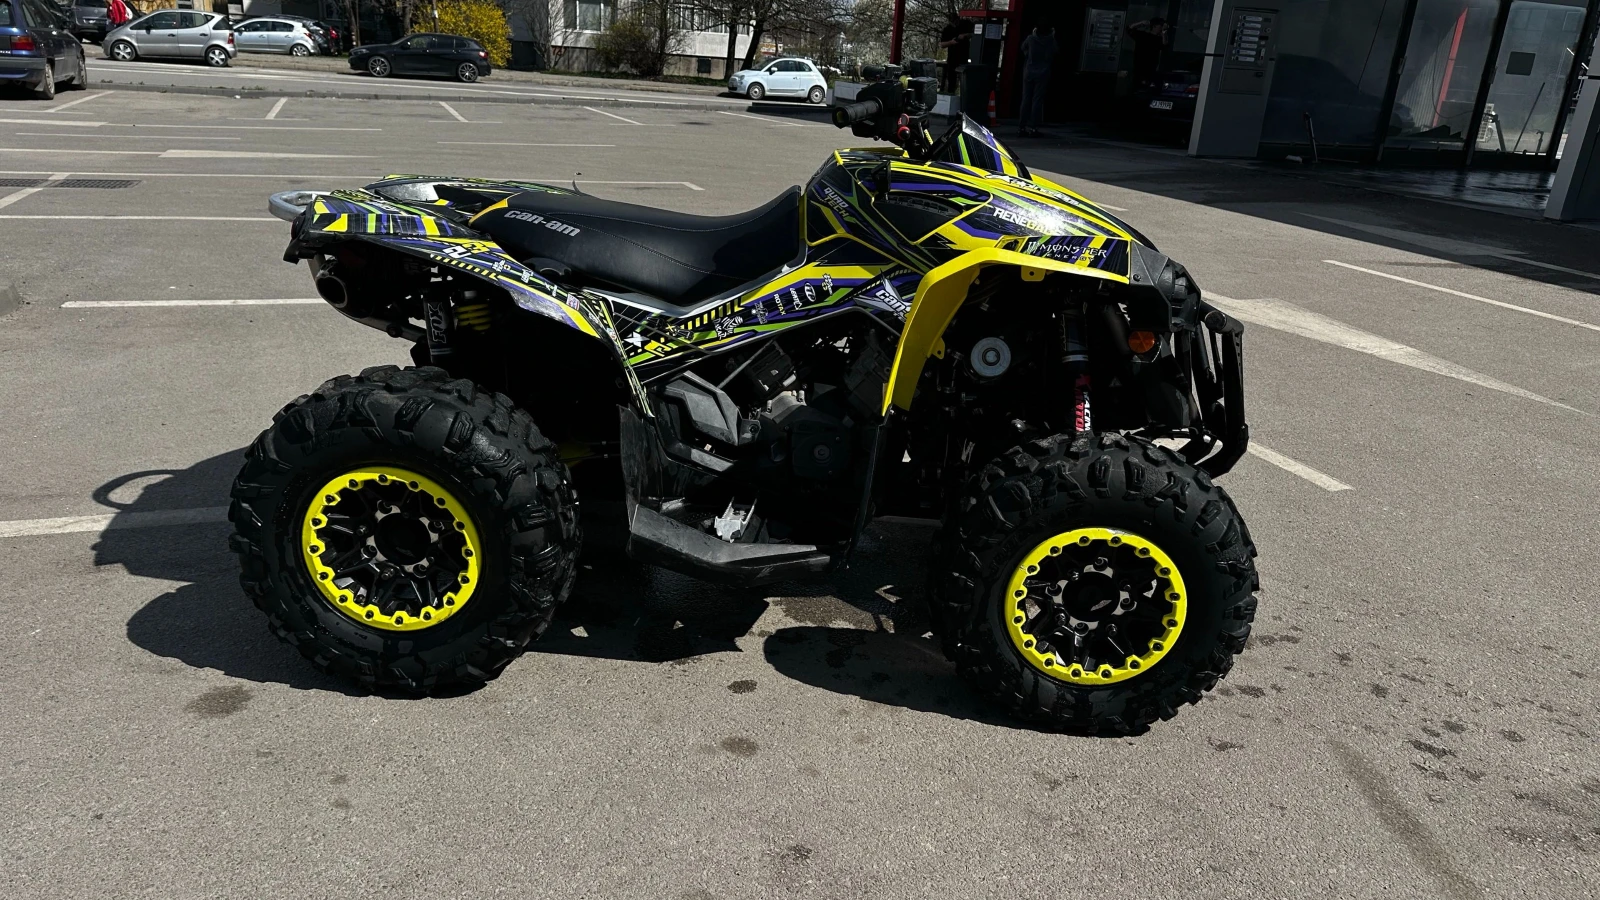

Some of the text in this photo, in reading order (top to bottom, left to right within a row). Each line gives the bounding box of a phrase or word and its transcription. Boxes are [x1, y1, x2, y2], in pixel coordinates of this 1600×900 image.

[824, 186, 849, 208] QUAD
[824, 195, 850, 217] TECH
[504, 210, 580, 236] can-am
[1046, 253, 1095, 262] ENERGY
[773, 293, 786, 316] ROTAX
[427, 301, 447, 344] FOX
